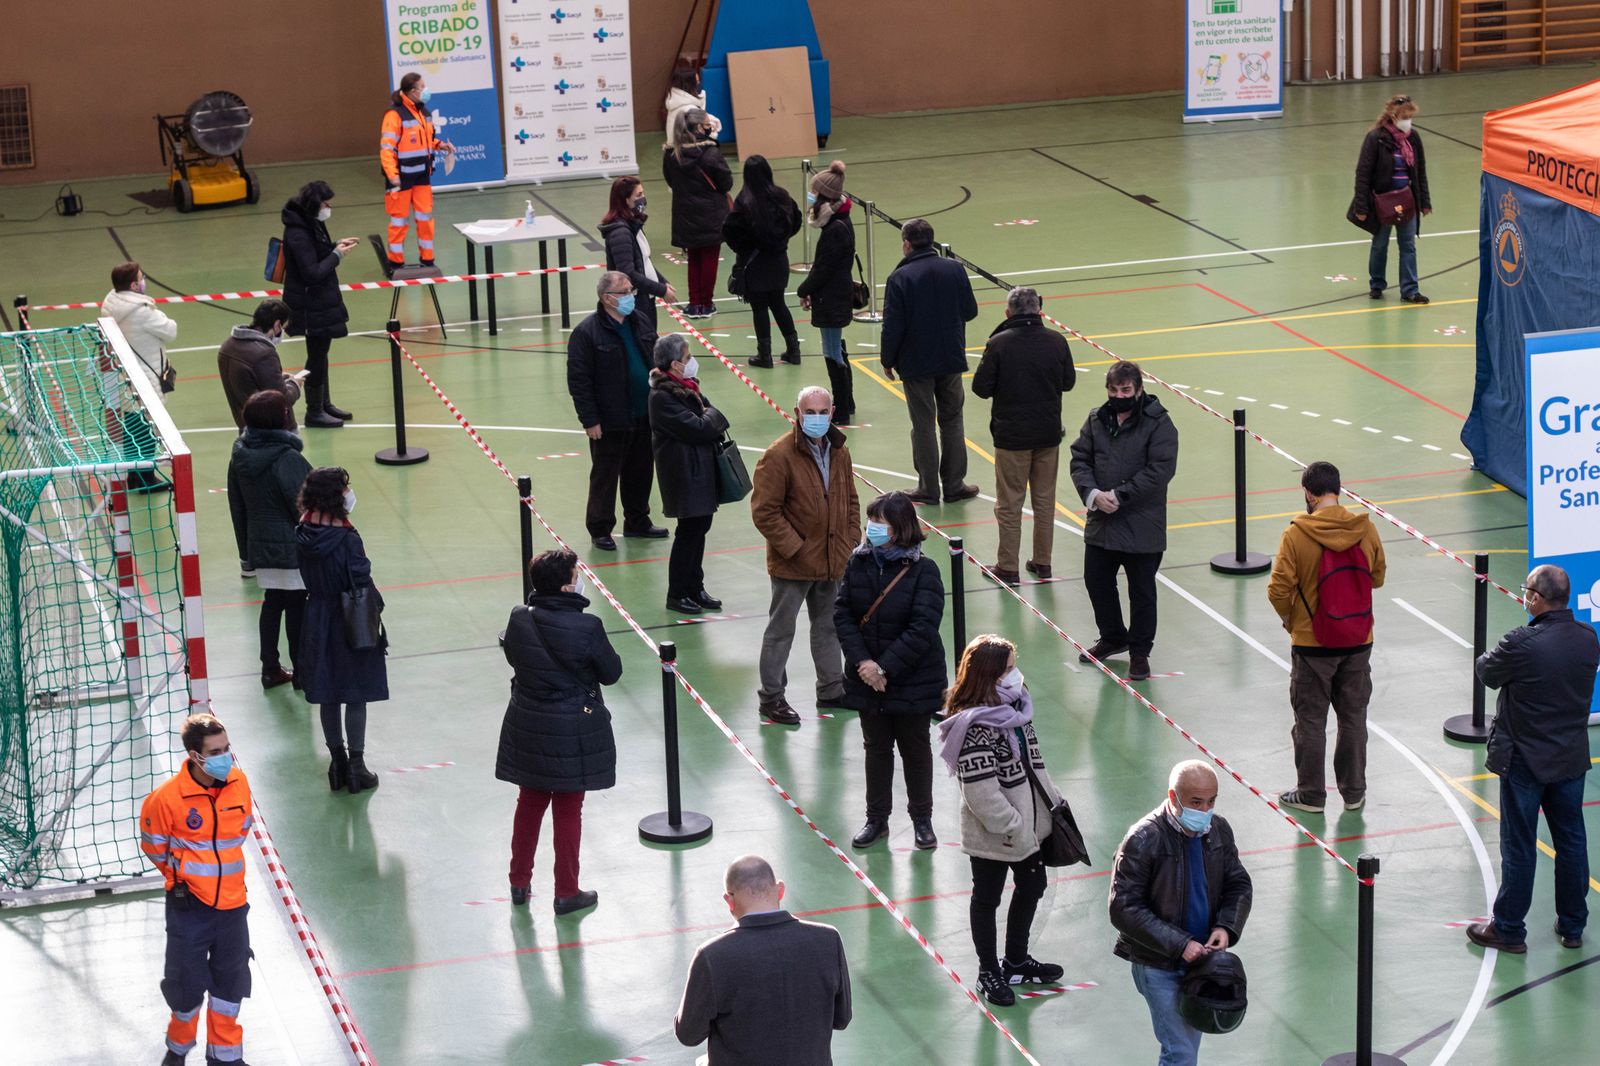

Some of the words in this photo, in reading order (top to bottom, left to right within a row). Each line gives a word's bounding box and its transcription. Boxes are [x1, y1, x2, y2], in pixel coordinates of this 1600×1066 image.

[398, 3, 458, 17] Programa
[462, 0, 477, 11] de
[399, 16, 479, 36] CRIBADO
[1192, 20, 1205, 28] Ten
[1217, 18, 1241, 27] tarjeta
[1243, 16, 1276, 24] sanitaria
[1207, 28, 1226, 37] vigor
[1241, 35, 1251, 43] de
[399, 35, 482, 55] COVID-19
[397, 58, 438, 67] Universidad
[450, 54, 486, 62] Salamanca
[448, 115, 471, 125] Sacyl
[1528, 149, 1599, 199] PROTECCI
[1540, 460, 1600, 485] Profe
[1560, 488, 1600, 509] San
